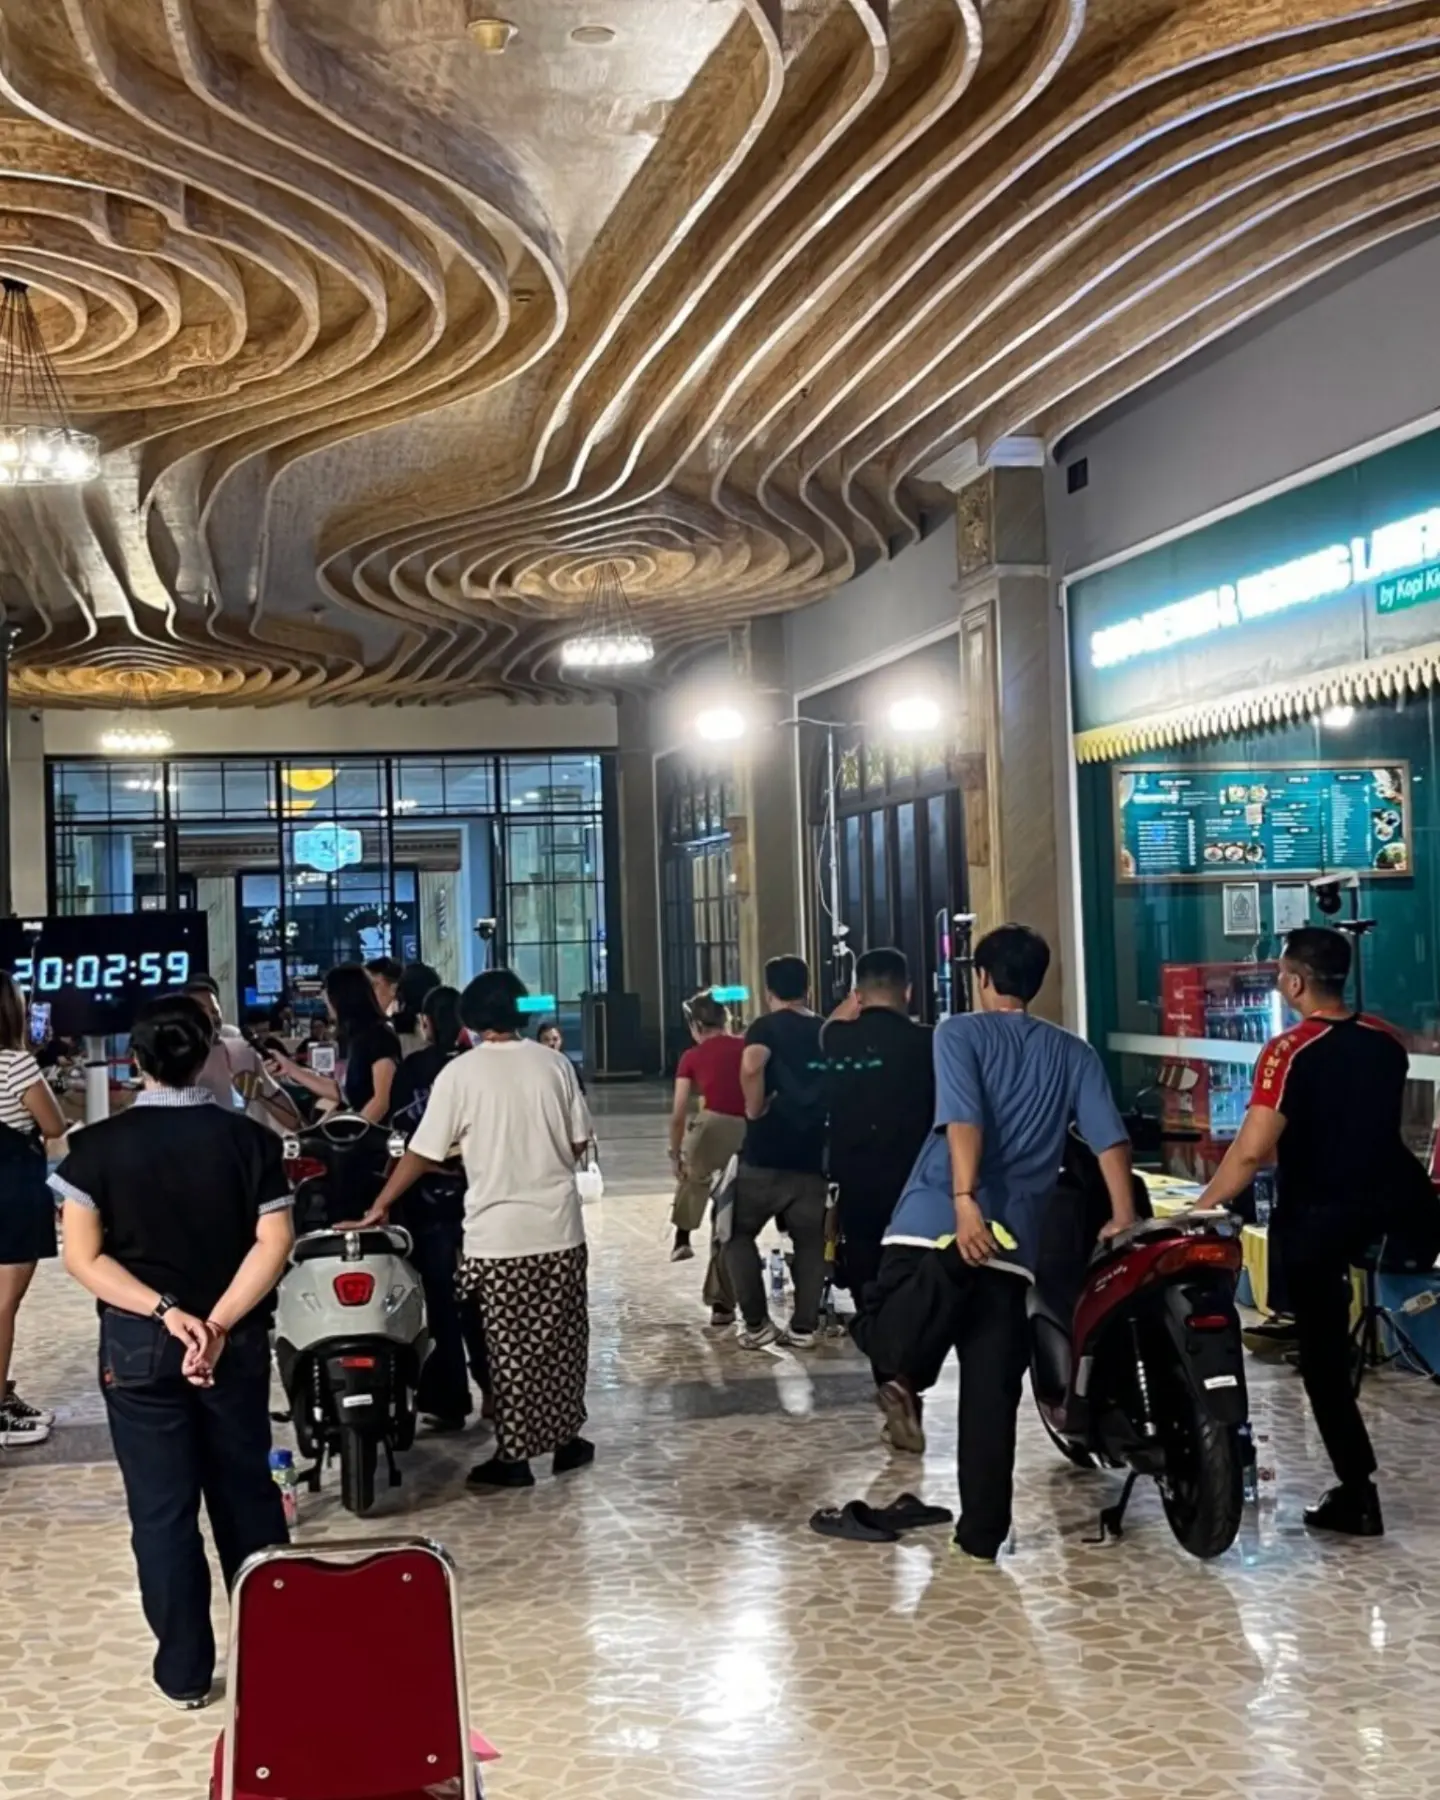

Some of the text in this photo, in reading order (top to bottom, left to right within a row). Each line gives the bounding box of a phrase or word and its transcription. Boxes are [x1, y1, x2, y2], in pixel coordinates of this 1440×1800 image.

[1380, 585, 1395, 608] by
[1396, 573, 1424, 601] Kopi
[13, 951, 189, 991] 20:02:59
